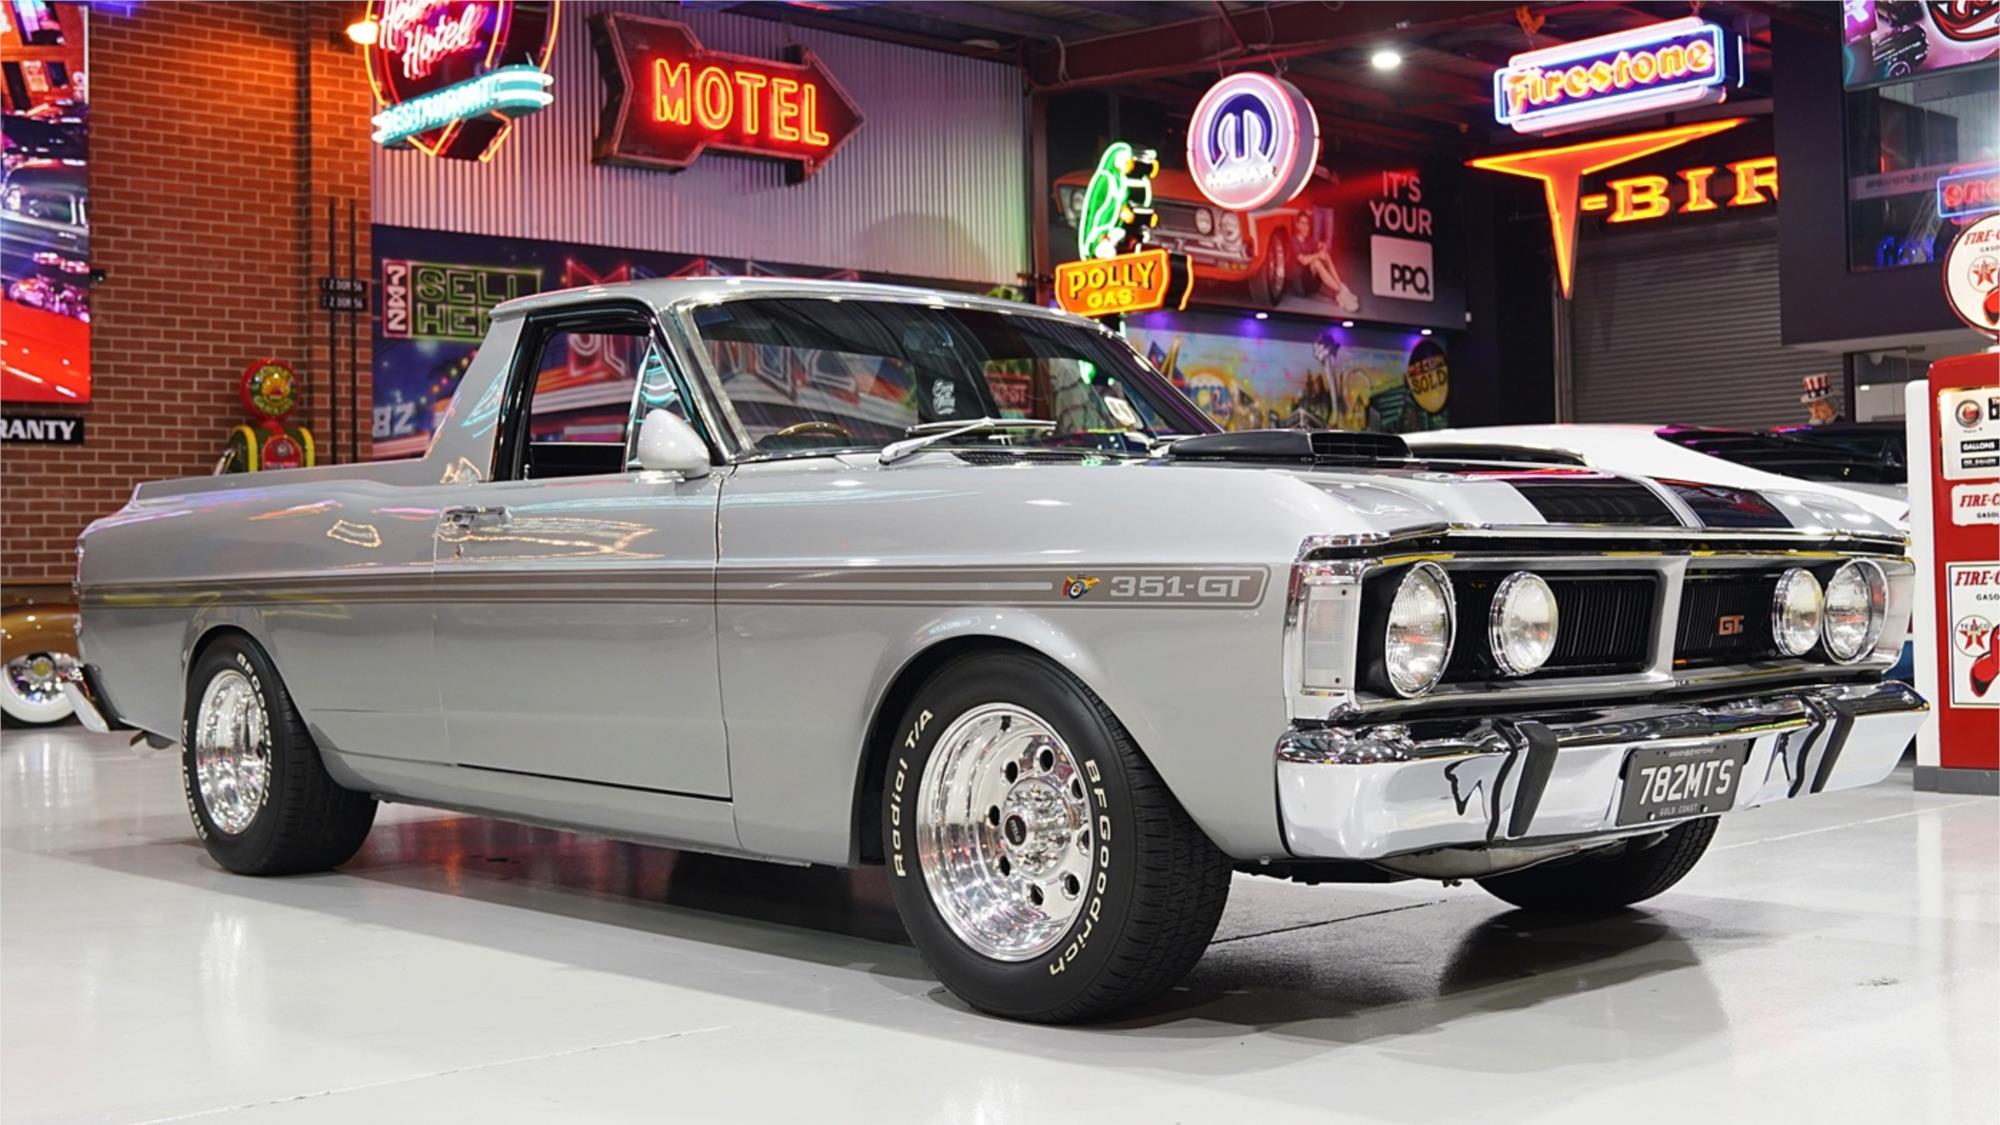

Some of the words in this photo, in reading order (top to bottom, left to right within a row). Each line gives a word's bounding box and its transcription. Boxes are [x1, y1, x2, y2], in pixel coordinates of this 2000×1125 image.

[402, 3, 478, 78] Hotel
[1507, 39, 1713, 116] Firestone
[656, 58, 829, 146] MOTEL
[1382, 170, 1422, 203] IT'S
[1369, 199, 1433, 236] YOUR
[1067, 261, 1155, 299] POLLY
[1390, 262, 1431, 297] PPQ
[1087, 288, 1133, 309] GAS
[1411, 370, 1447, 395] SOLD
[1962, 442, 1995, 451] GALLONS
[1110, 575, 1250, 598] 351-GT
[904, 709, 934, 750] T/A
[1640, 759, 1735, 806] 782MTS
[891, 758, 908, 877] Radial
[1659, 806, 1677, 817] GOLD
[1678, 803, 1699, 814] COAST
[1049, 759, 1111, 976] BFGoodrich
